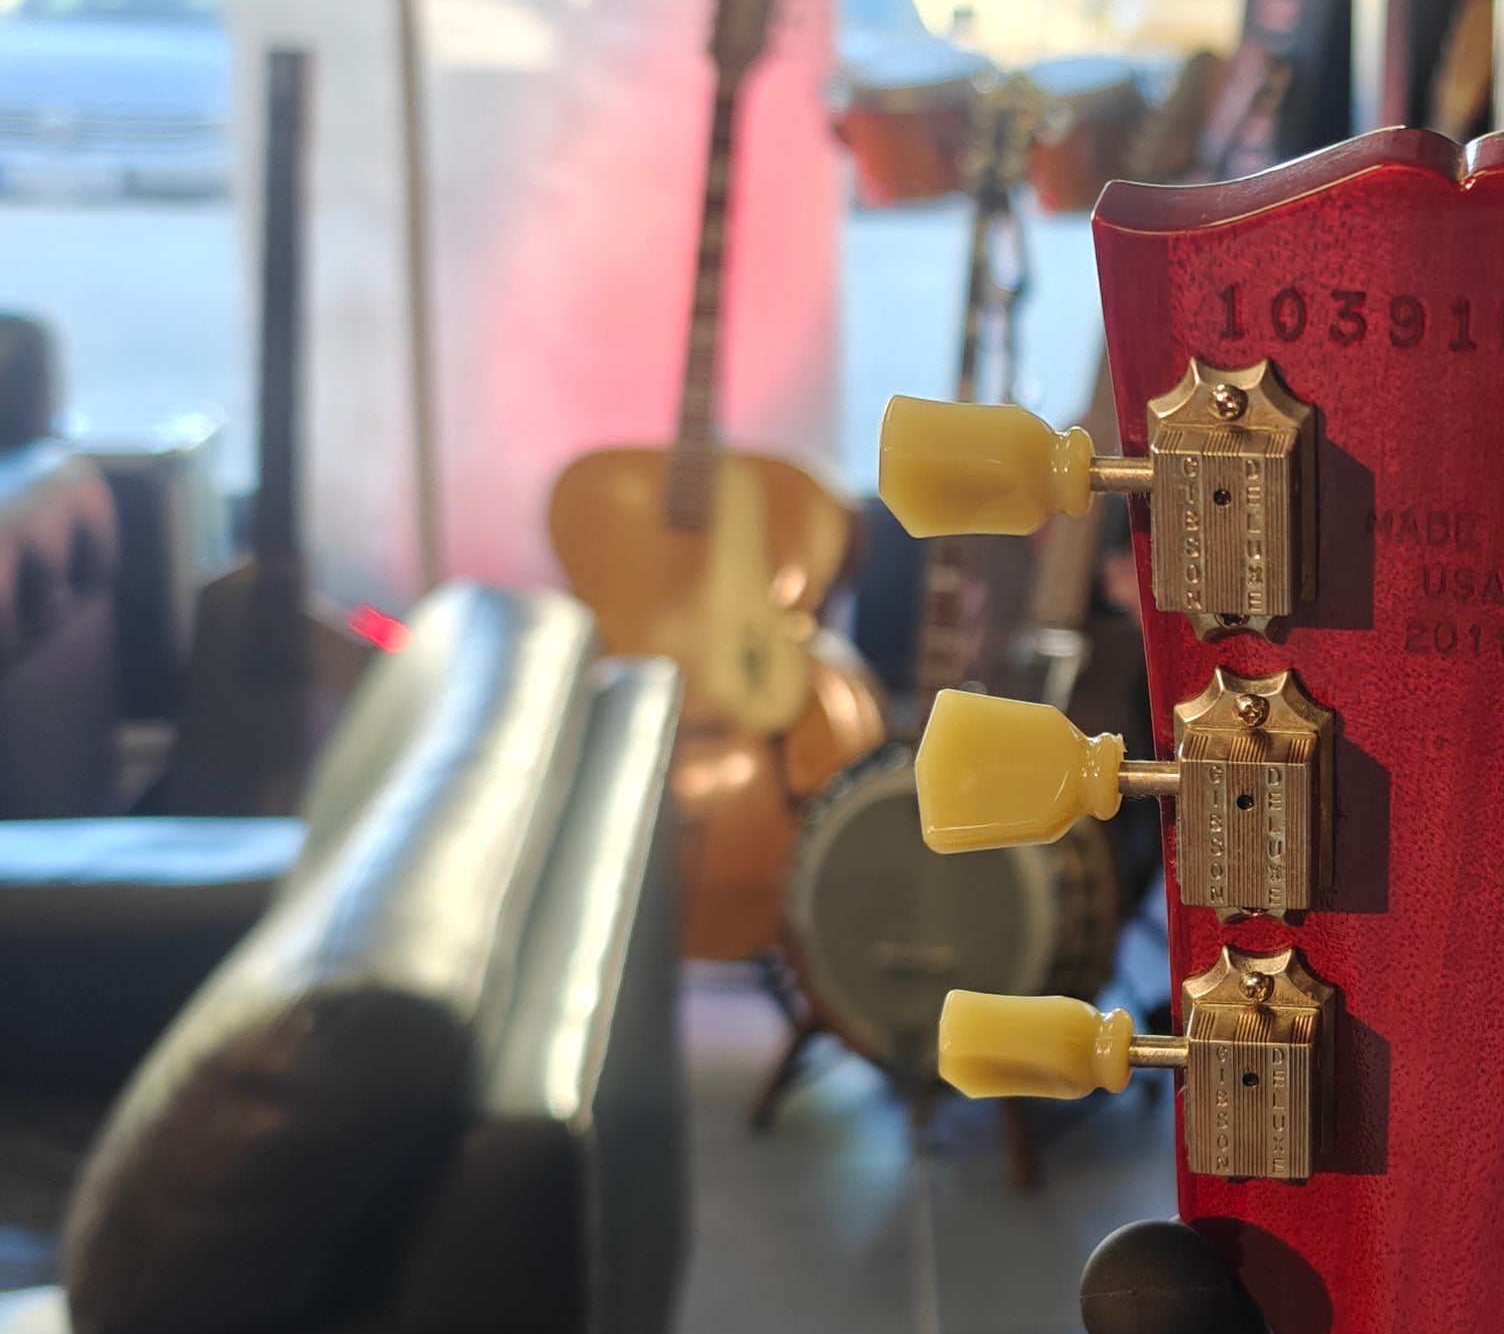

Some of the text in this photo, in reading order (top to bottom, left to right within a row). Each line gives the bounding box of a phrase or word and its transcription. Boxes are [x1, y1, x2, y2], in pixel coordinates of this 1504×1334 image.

[1246, 458, 1264, 612] DELUXE
[1366, 510, 1482, 550] MADE
[1208, 765, 1224, 904] GIBSON
[1267, 767, 1282, 907] DELUXE
[1216, 1045, 1229, 1172] GIBSON
[1272, 1047, 1286, 1175] DELUXE
